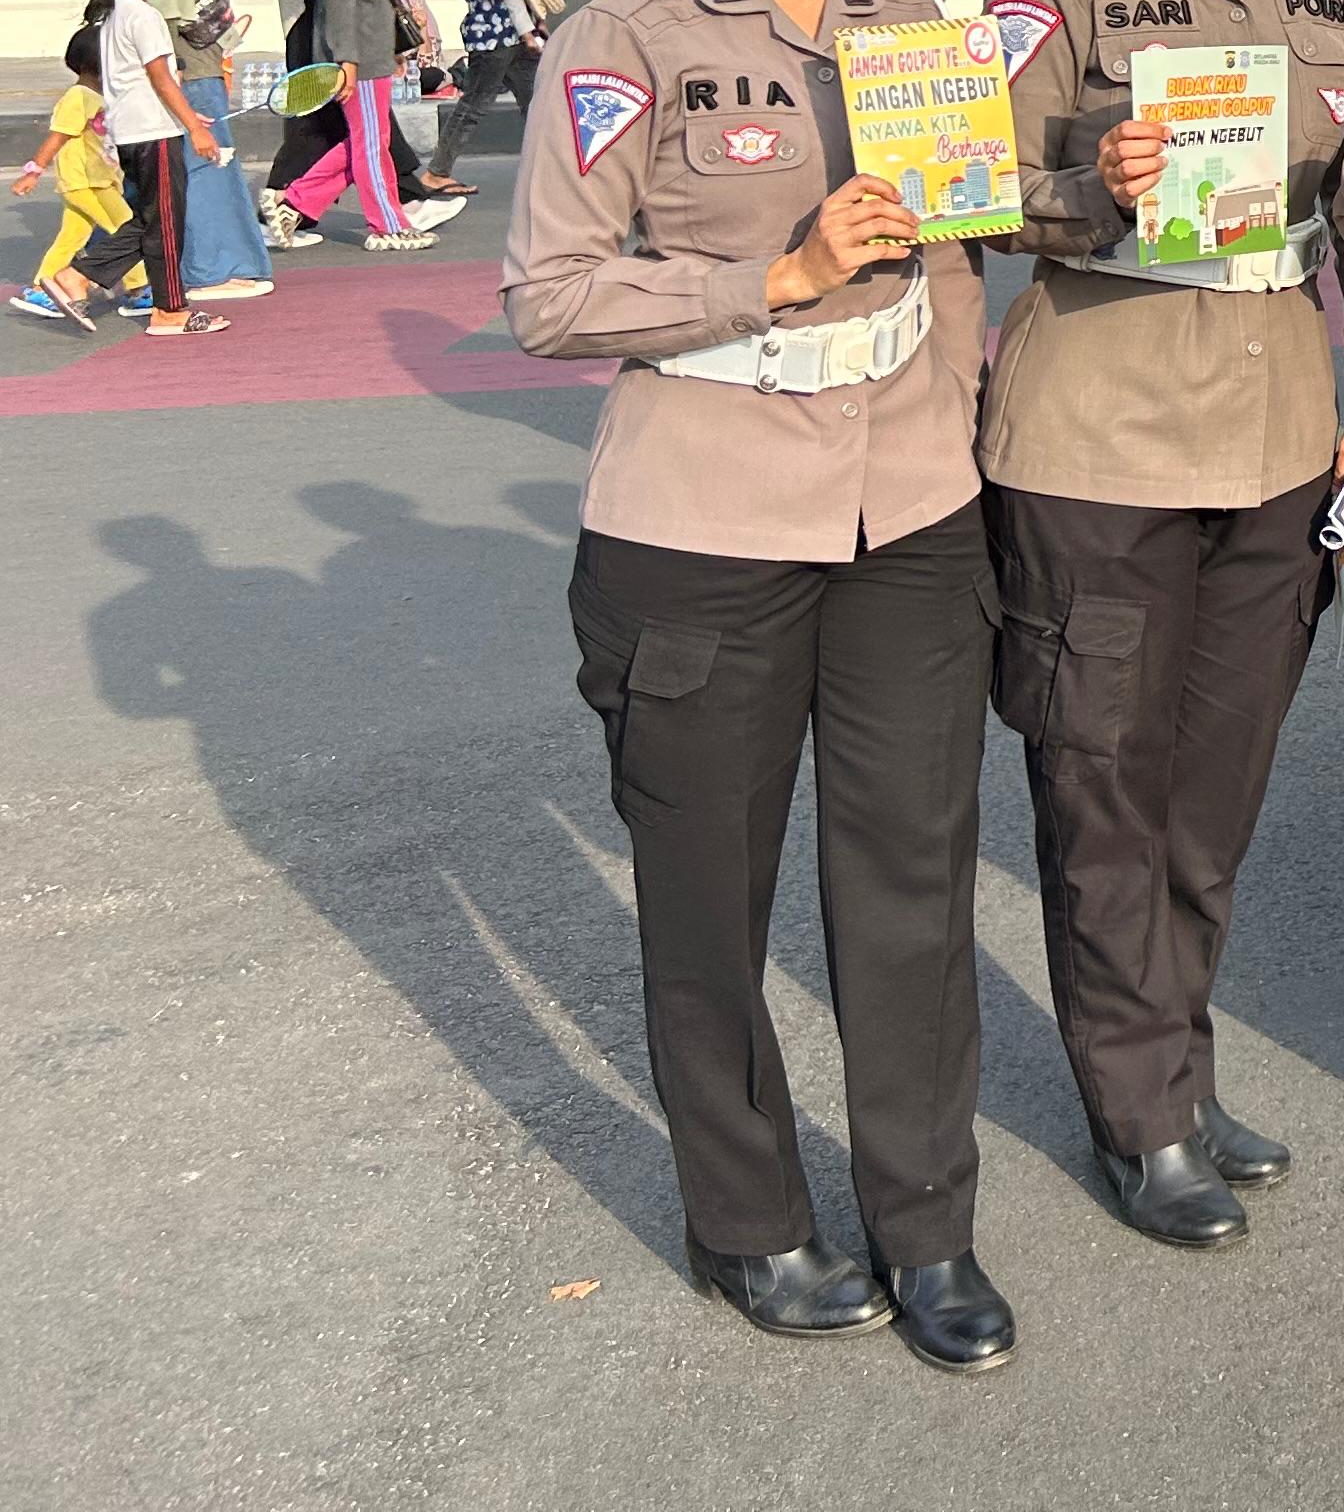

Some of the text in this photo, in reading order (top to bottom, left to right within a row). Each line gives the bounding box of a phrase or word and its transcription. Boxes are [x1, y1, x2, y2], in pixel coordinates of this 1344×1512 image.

[1104, 0, 1193, 28] SARI
[849, 53, 894, 78] JANGAN
[898, 49, 941, 74] GOLPUT
[685, 76, 796, 111] RIA
[854, 76, 1000, 112] JANGAN NGEBUT
[1167, 74, 1248, 98] BUDAK RIAU
[1140, 96, 1277, 124] TAK PERNAH GOLPUT
[859, 114, 971, 143] NYAWA KITA
[1211, 126, 1265, 144] NGEBUT
[937, 134, 1008, 165] Berharga
